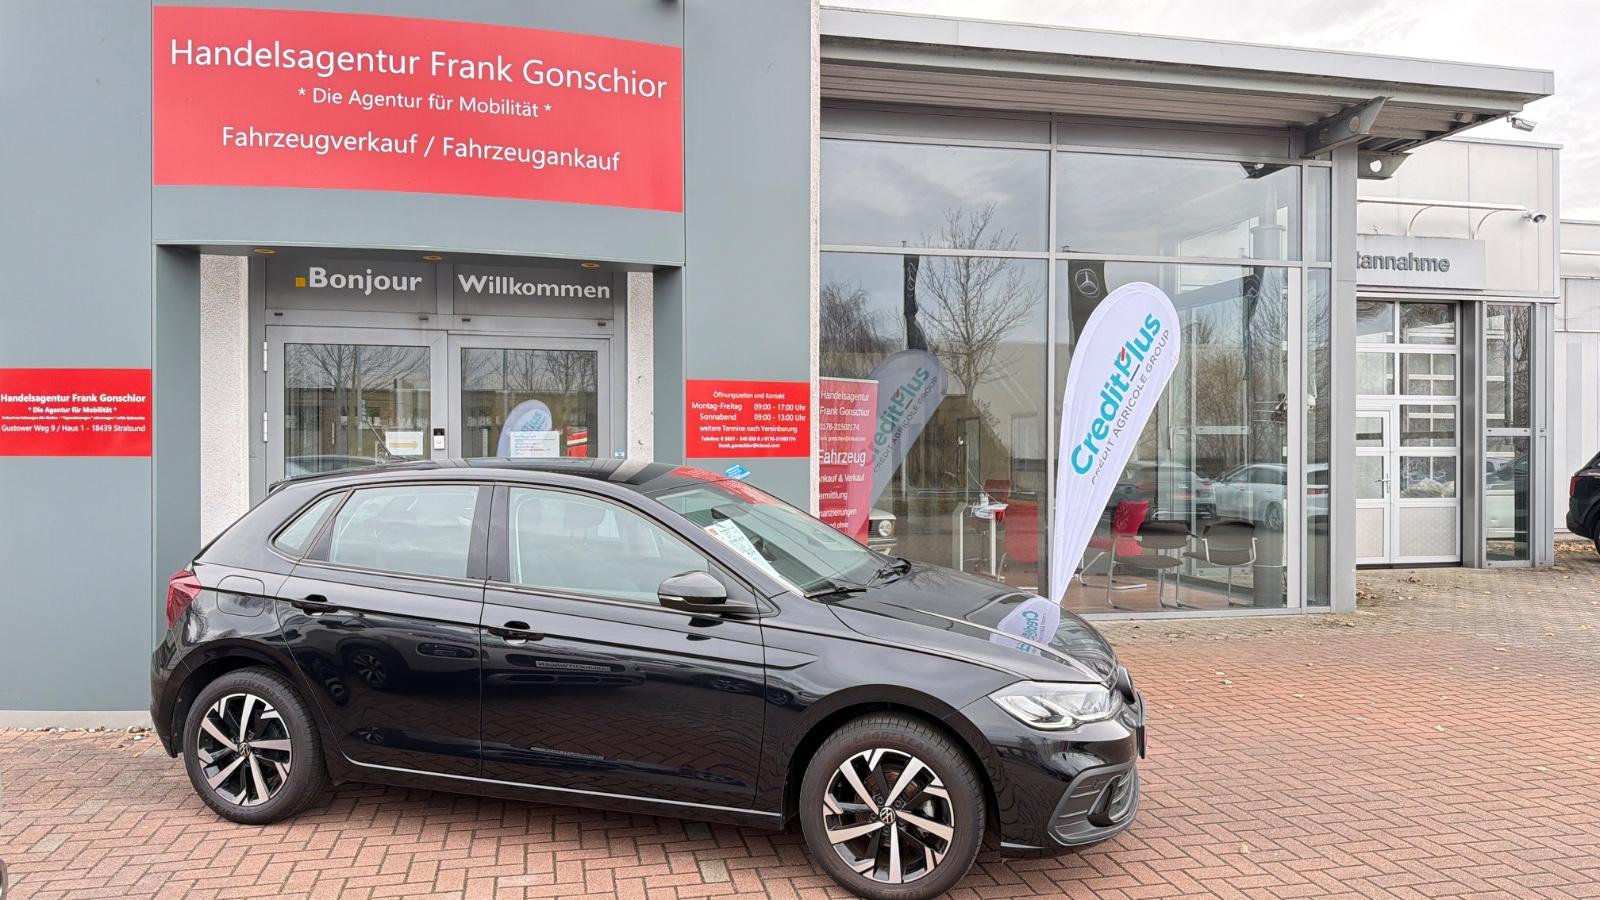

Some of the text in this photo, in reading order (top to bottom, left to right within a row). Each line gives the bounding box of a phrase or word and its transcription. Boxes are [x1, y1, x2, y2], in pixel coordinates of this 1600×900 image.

[170, 38, 668, 98] Handelsagentur Frank Gonschior
[312, 87, 343, 105] Die
[348, 90, 423, 110] Agentur
[427, 93, 452, 111] für
[459, 96, 540, 118] Mobilität
[221, 126, 621, 172] Fahrzeugverkauf / Fahrzeugankauf
[309, 266, 422, 296] Bonjour
[458, 274, 611, 299] Willkommen
[1113, 375, 1148, 439] AGRICOLE
[1145, 329, 1170, 373] GROUP
[0, 393, 147, 404] Handelsagentur Frank Gonschior
[820, 391, 870, 403] Handelsagentur
[1070, 312, 1161, 476] CreditPlus
[44, 407, 70, 415] Agentur
[691, 401, 743, 412] Montag-Freitag
[753, 403, 772, 411] 09:00
[777, 403, 794, 411] 17:00
[819, 406, 871, 417] Frank Gonschior
[699, 413, 737, 421] Sonnabend
[753, 413, 772, 421] 09:00
[777, 413, 794, 421] 13:00
[794, 413, 806, 421] Uhr
[1, 424, 32, 432] Gustower
[34, 425, 49, 433] Weg
[113, 424, 146, 432] Stralsund
[818, 449, 866, 467] Fahrzeug
[819, 473, 865, 483] nkauf & Verkauf
[819, 491, 849, 501] ermittlung
